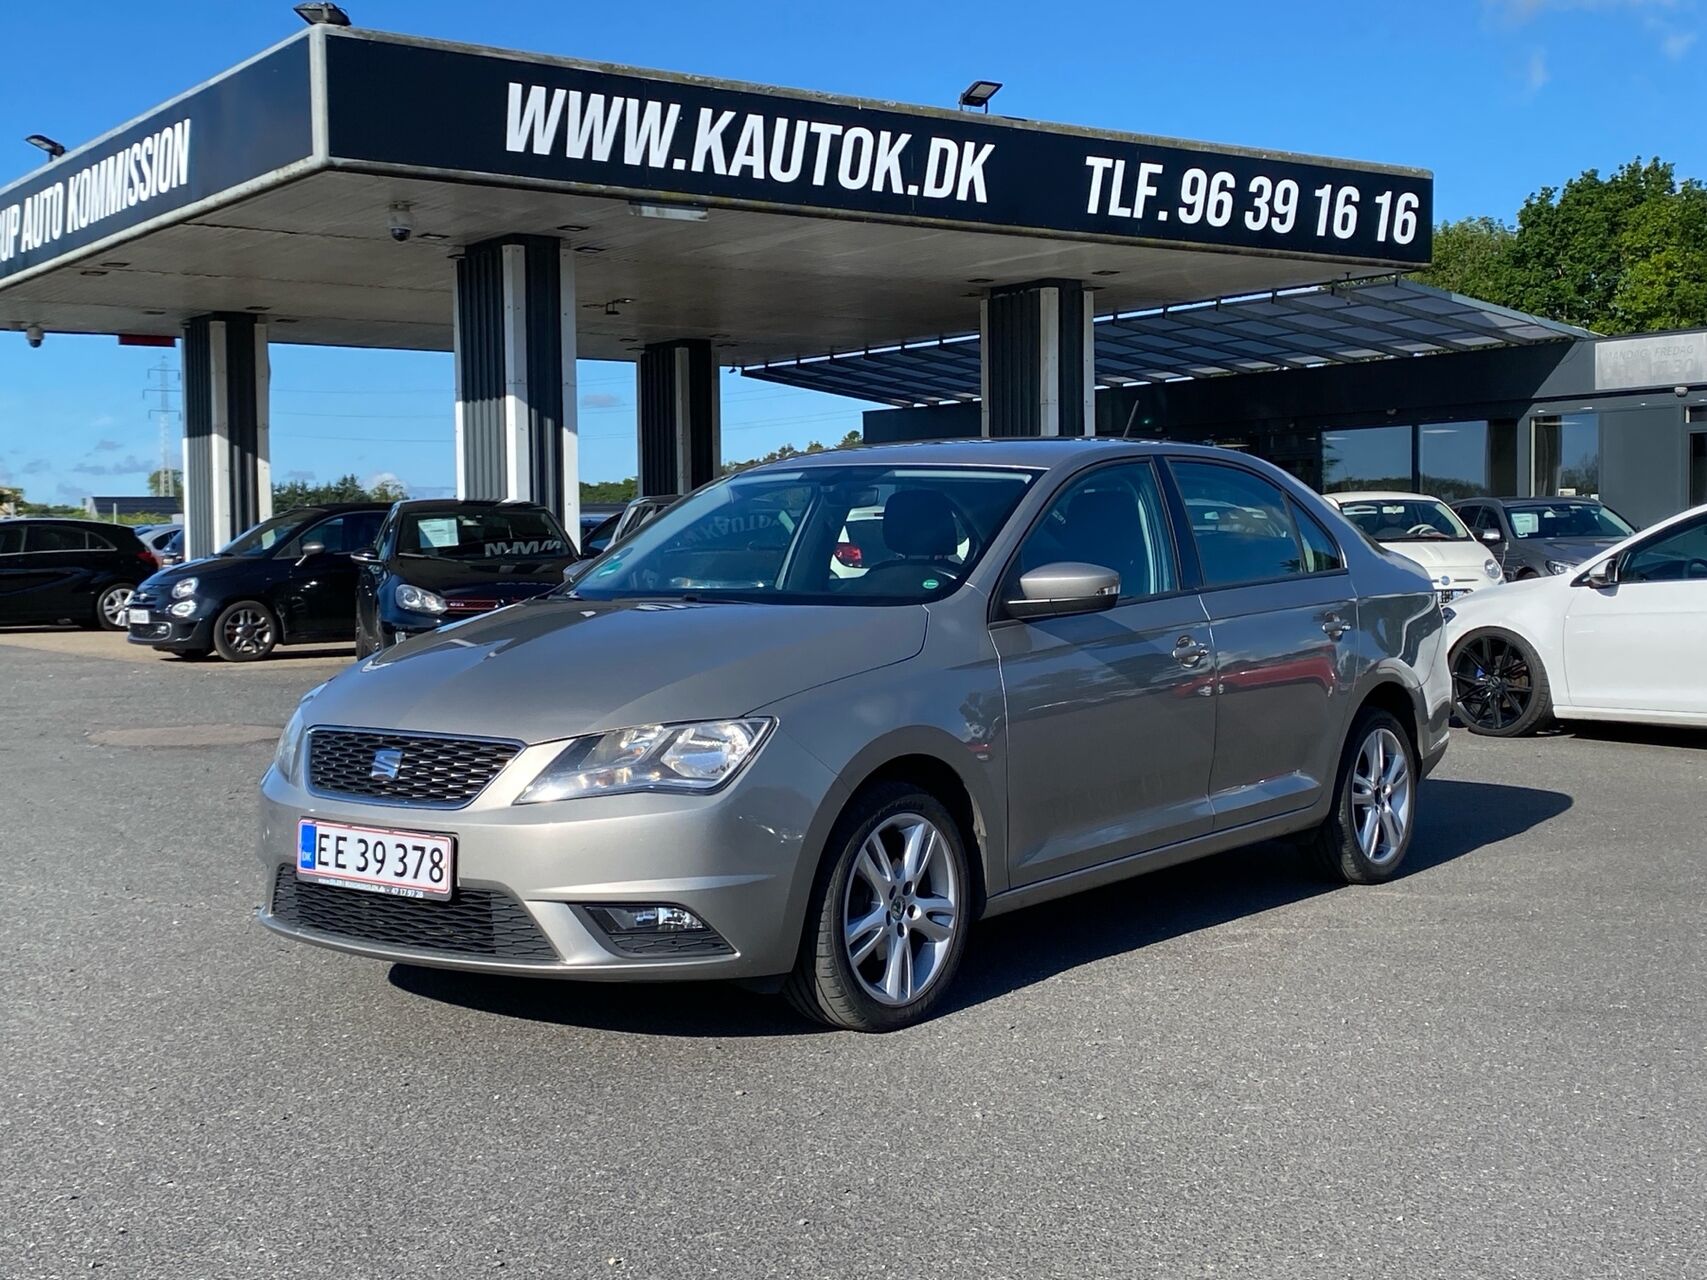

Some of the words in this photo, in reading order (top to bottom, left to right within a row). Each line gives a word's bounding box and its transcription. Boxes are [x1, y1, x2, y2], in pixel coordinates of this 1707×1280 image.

[506, 82, 996, 203] WWW.KAUTOK.DK
[0, 204, 20, 263] UP
[20, 182, 64, 253] AUTO
[66, 118, 191, 234] KOMMISSION
[1085, 155, 1168, 221] TLF.
[1178, 168, 1236, 227] 96
[1244, 176, 1299, 234] 39
[1314, 184, 1360, 239] 16
[1375, 190, 1419, 245] 16
[1655, 344, 1695, 357] FREDAG
[317, 833, 348, 870] EE
